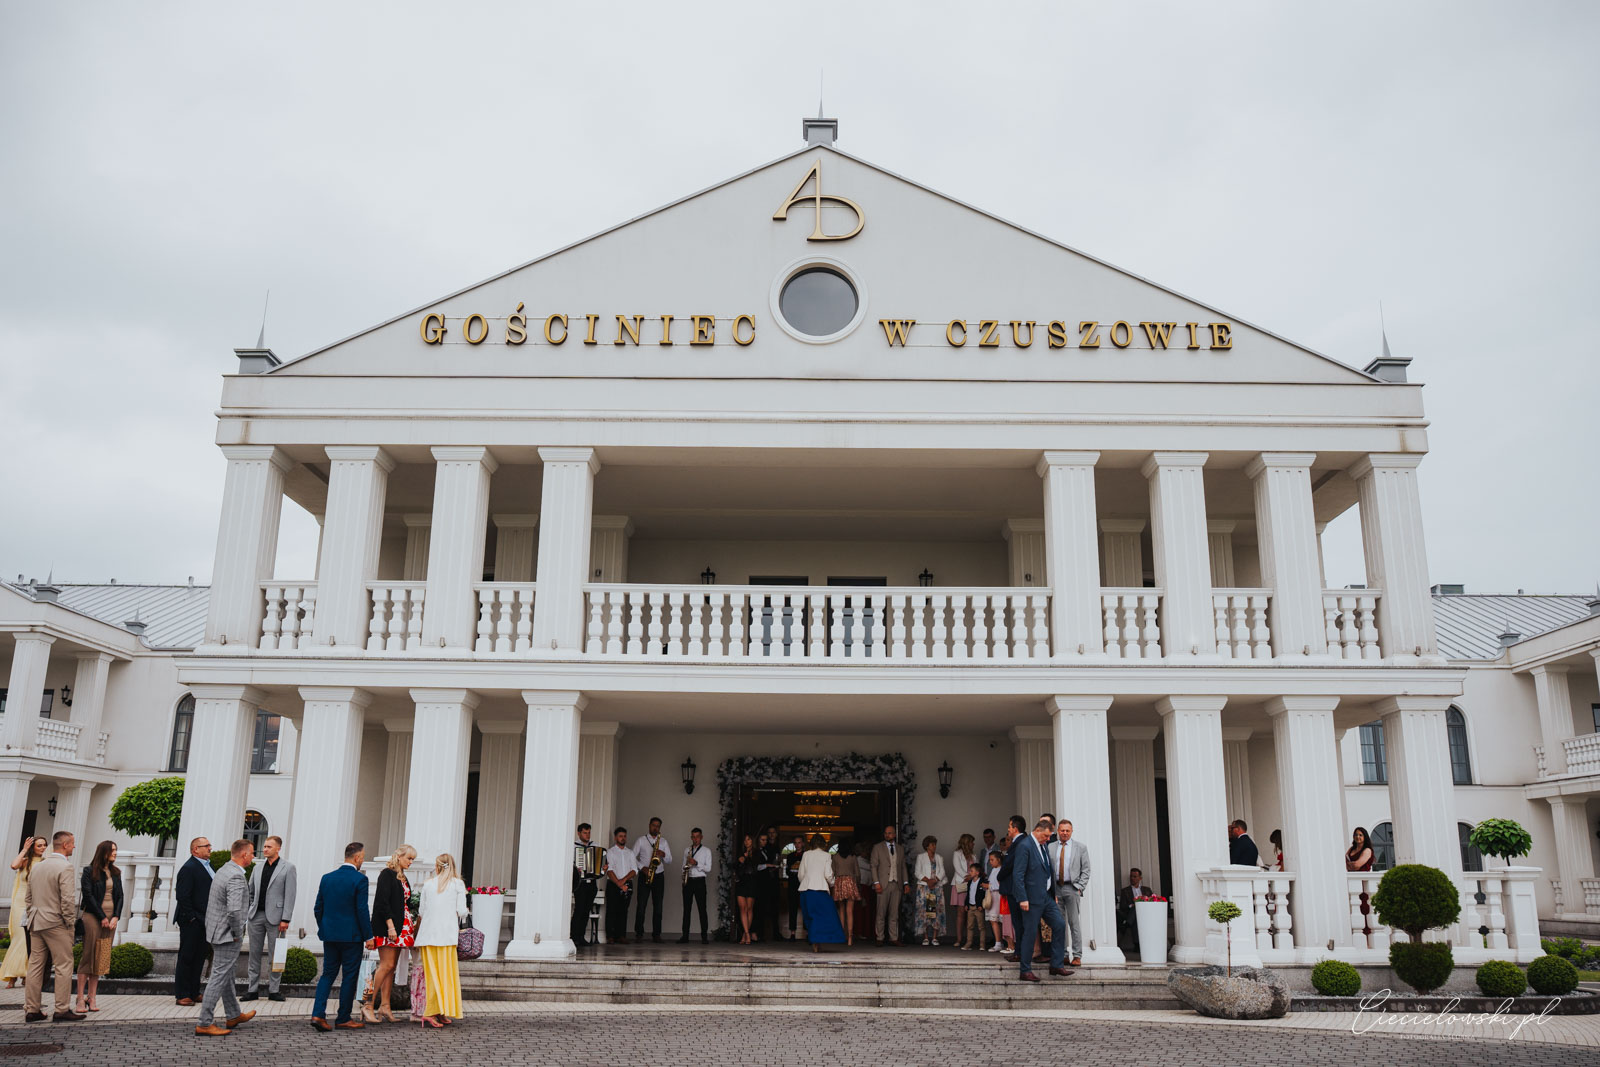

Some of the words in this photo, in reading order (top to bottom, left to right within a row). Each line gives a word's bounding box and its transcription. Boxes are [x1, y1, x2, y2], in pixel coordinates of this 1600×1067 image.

[420, 302, 756, 346] GOŚCINIEC
[879, 319, 916, 347] W
[946, 319, 1233, 350] CZUSZOWIE
